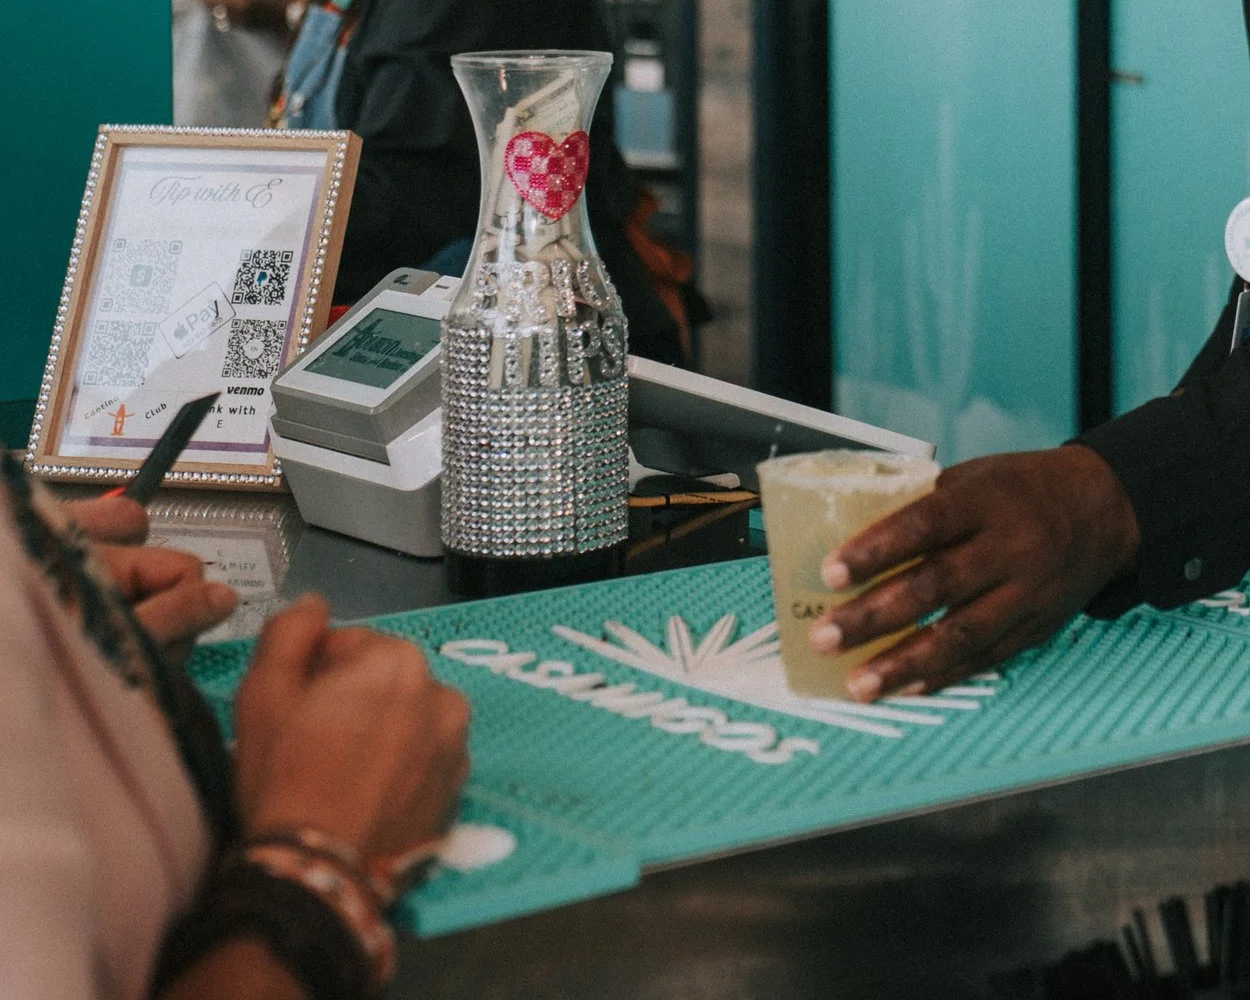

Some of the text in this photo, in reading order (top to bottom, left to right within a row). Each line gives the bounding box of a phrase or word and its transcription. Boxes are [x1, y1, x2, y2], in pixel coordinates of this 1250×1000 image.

[149, 175, 202, 206] Tip
[194, 182, 241, 202] with
[186, 300, 219, 331] Pay
[227, 386, 265, 396] venmo
[145, 403, 167, 420] Club
[228, 405, 256, 416] with
[216, 419, 224, 429] E
